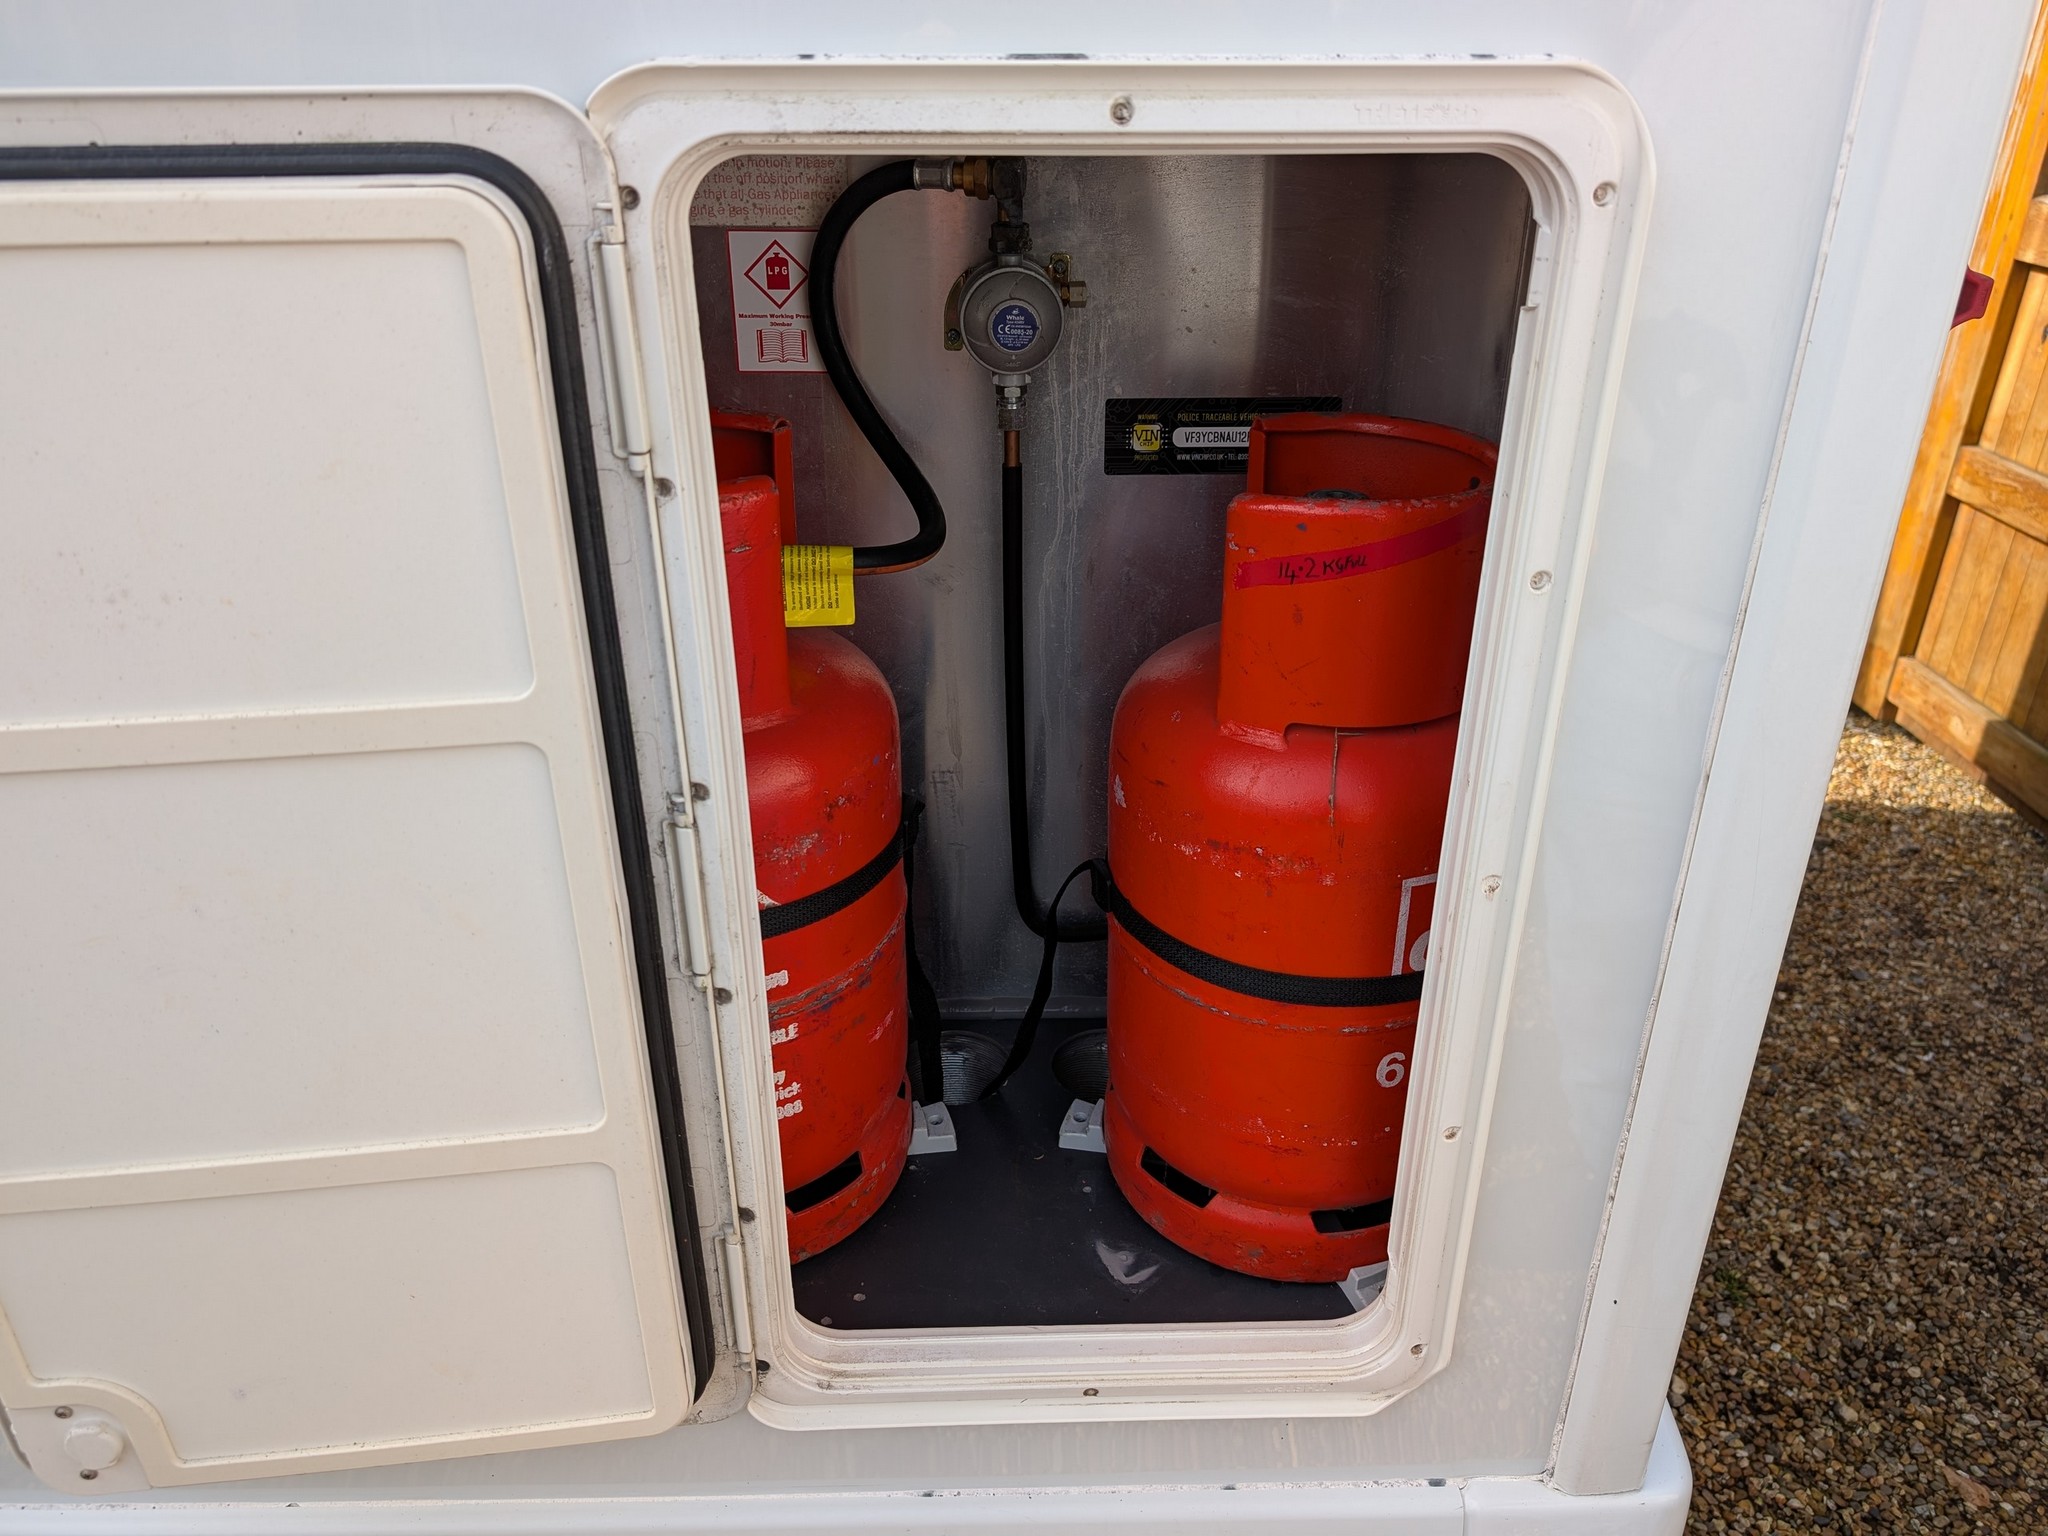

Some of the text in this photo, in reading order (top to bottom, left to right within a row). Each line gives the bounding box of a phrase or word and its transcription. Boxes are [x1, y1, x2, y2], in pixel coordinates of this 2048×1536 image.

[795, 156, 835, 168] Please
[714, 172, 732, 184] the
[736, 172, 752, 184] off
[756, 173, 802, 186] position
[806, 173, 837, 184] when
[704, 189, 726, 200] that
[730, 189, 744, 200] all
[748, 188, 770, 200] Gas
[774, 188, 838, 202] Appliances
[718, 206, 725, 215] a
[728, 206, 750, 218] gas
[1178, 413, 1200, 421] POLICE
[1202, 412, 1237, 421] TRACEABLE
[1133, 430, 1160, 442] VIN
[1184, 431, 1250, 443] VF3YCBNAU12
[1376, 1052, 1406, 1088] 6
